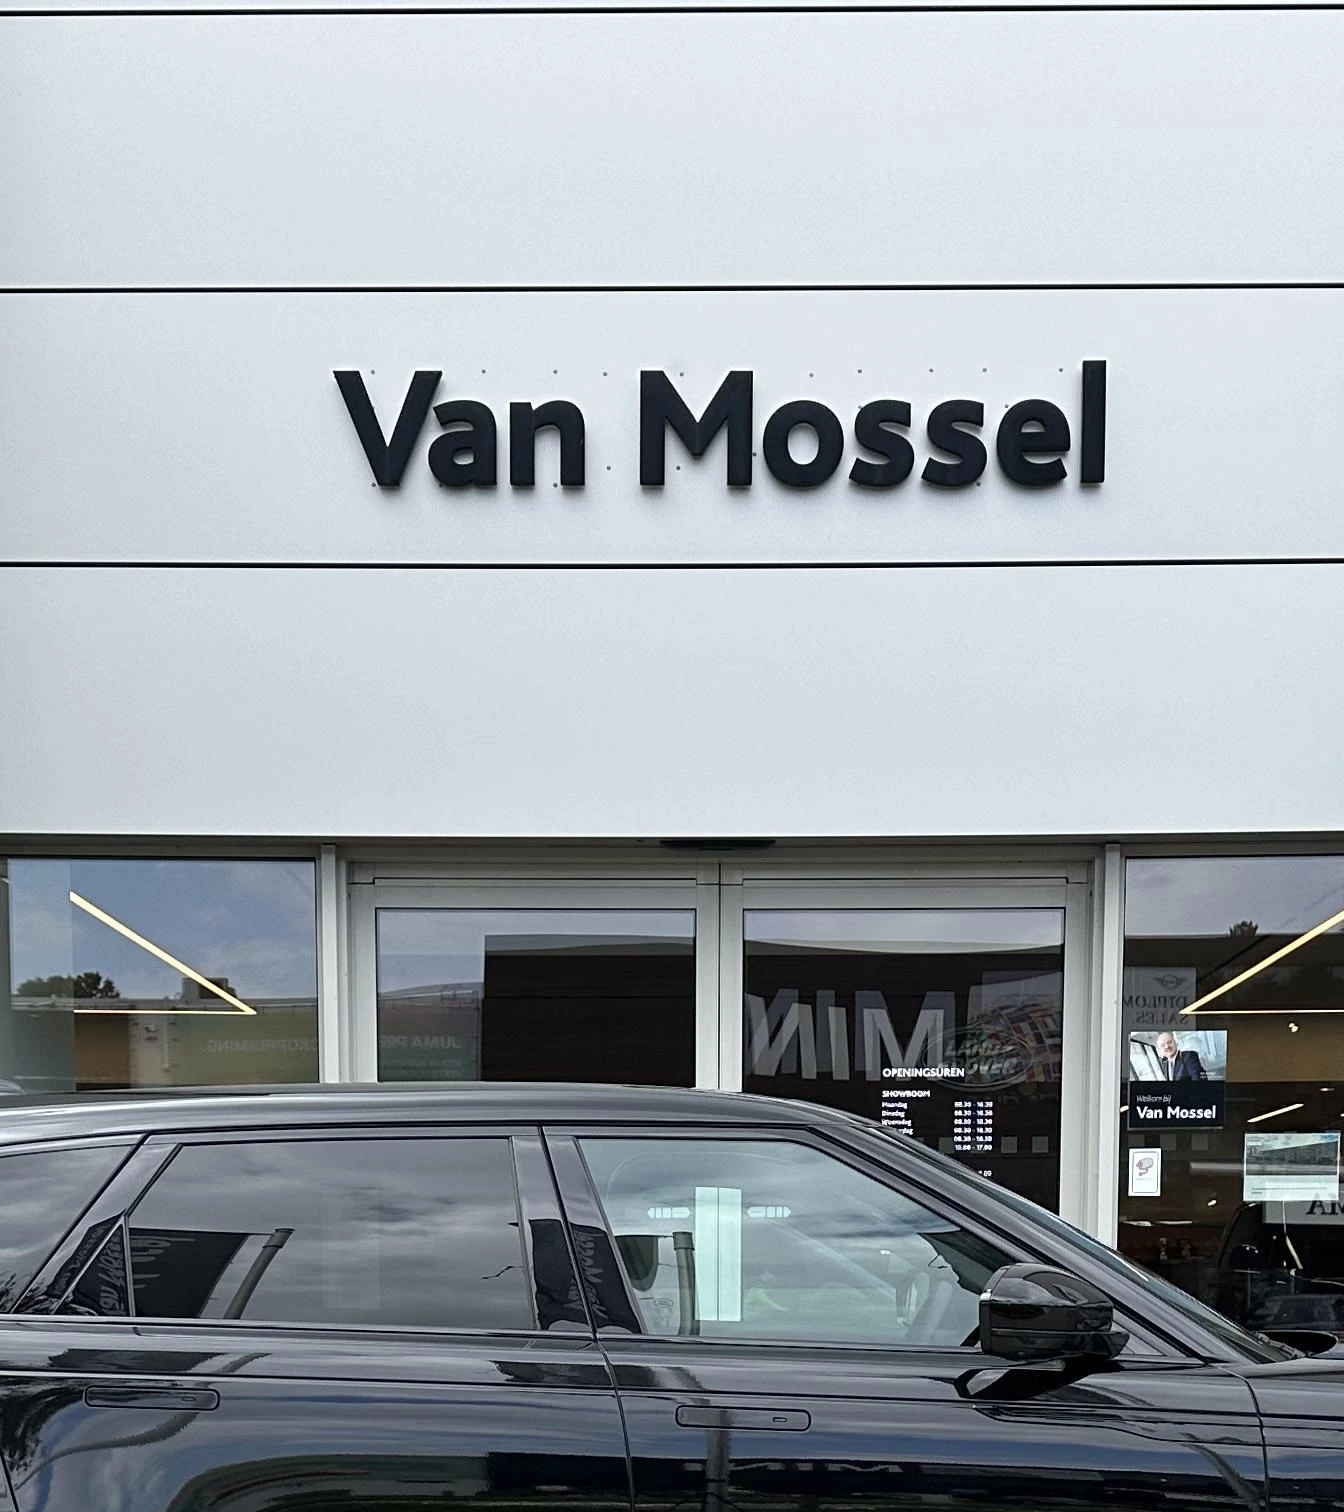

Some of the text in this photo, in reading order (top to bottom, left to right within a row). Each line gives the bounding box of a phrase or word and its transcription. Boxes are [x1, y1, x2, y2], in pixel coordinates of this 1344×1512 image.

[332, 359, 1108, 488] Van Mossel
[882, 1067, 965, 1078] OPENINGSUREN
[881, 1089, 931, 1098] SHOWROOM
[1136, 1104, 1216, 1119] Van Mossel
